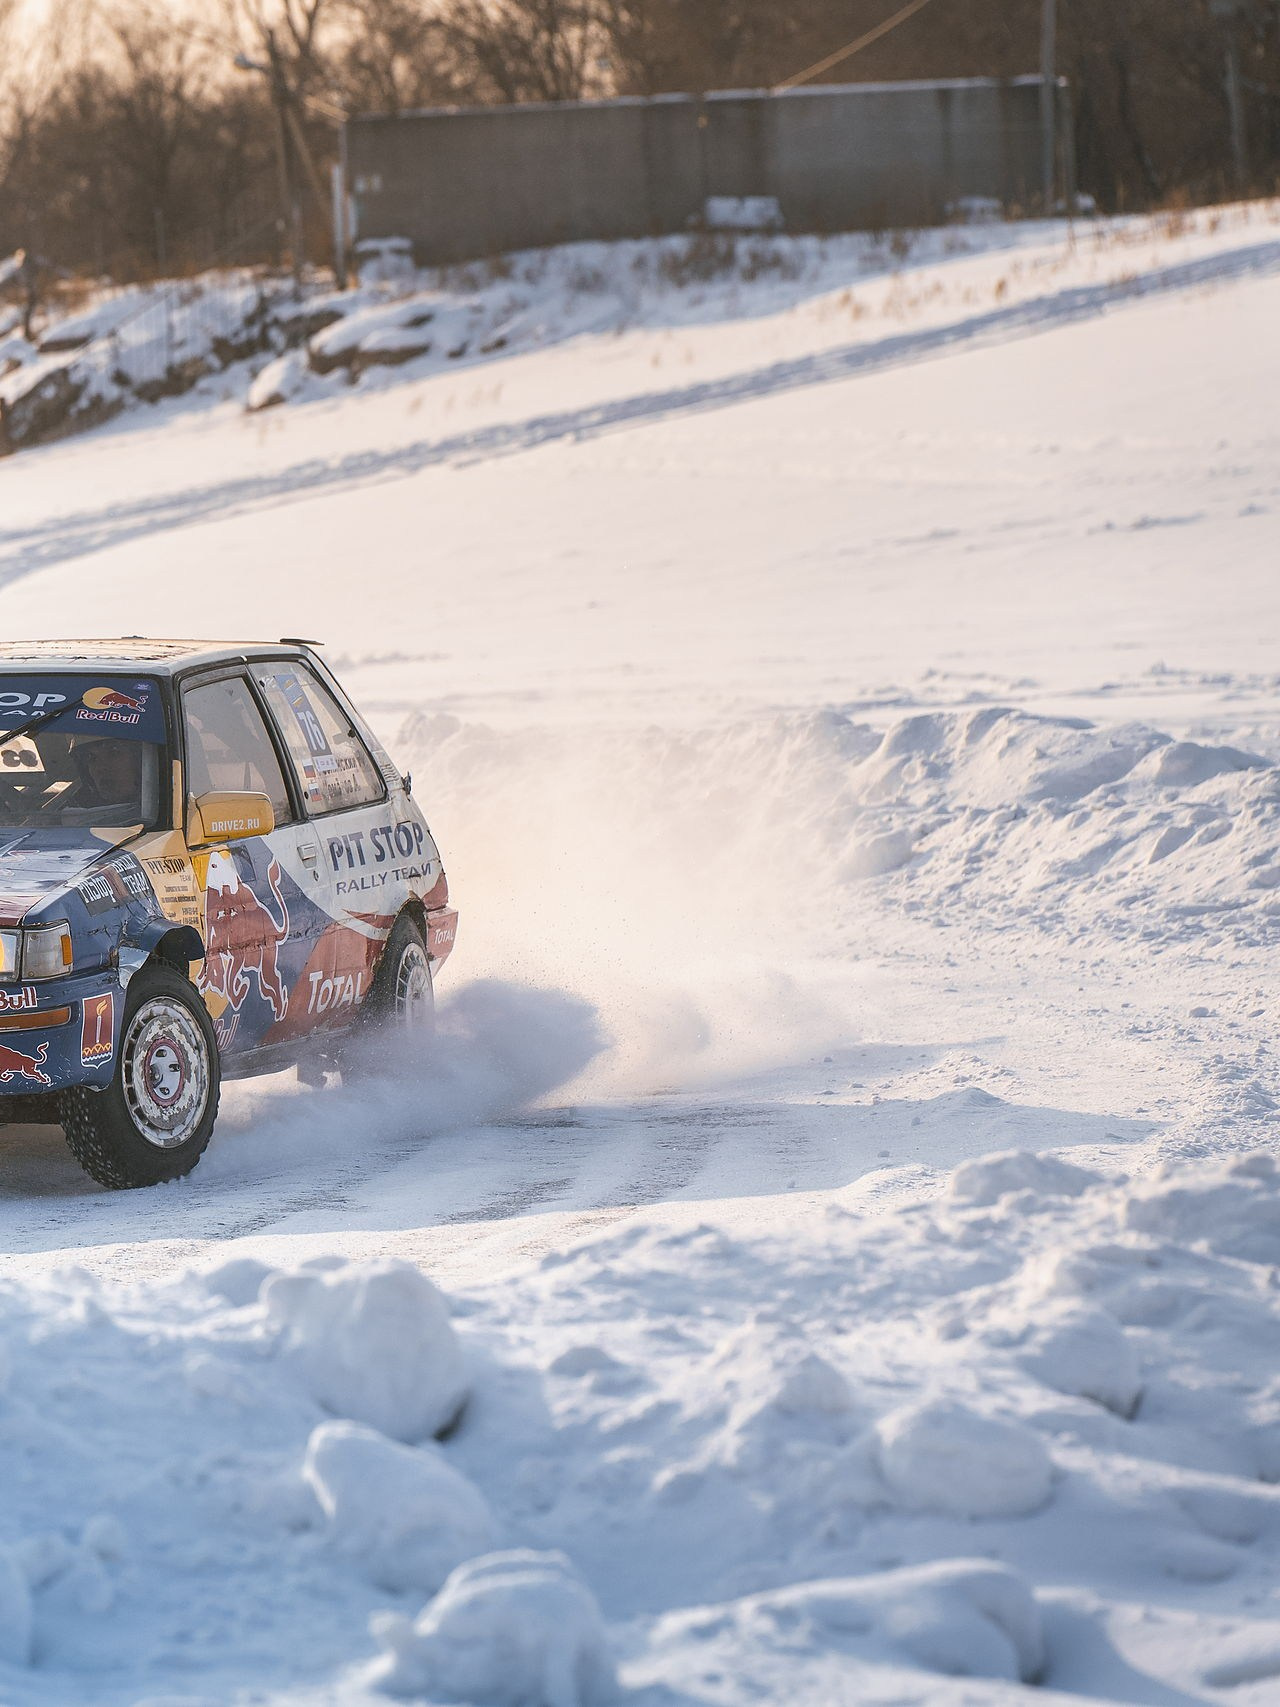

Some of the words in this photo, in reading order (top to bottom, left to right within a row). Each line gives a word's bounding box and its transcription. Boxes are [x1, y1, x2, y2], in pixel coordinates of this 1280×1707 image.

[75, 708, 107, 722] Red
[108, 710, 140, 724] Bull
[296, 710, 326, 751] 76
[211, 817, 260, 832] DRIVE2.RU
[326, 831, 366, 872] PIT
[369, 822, 424, 862] STOP
[122, 872, 150, 895] TEAM
[336, 871, 388, 895] RALLY
[434, 928, 455, 945] TOTAL
[307, 970, 364, 1014] TOTAL
